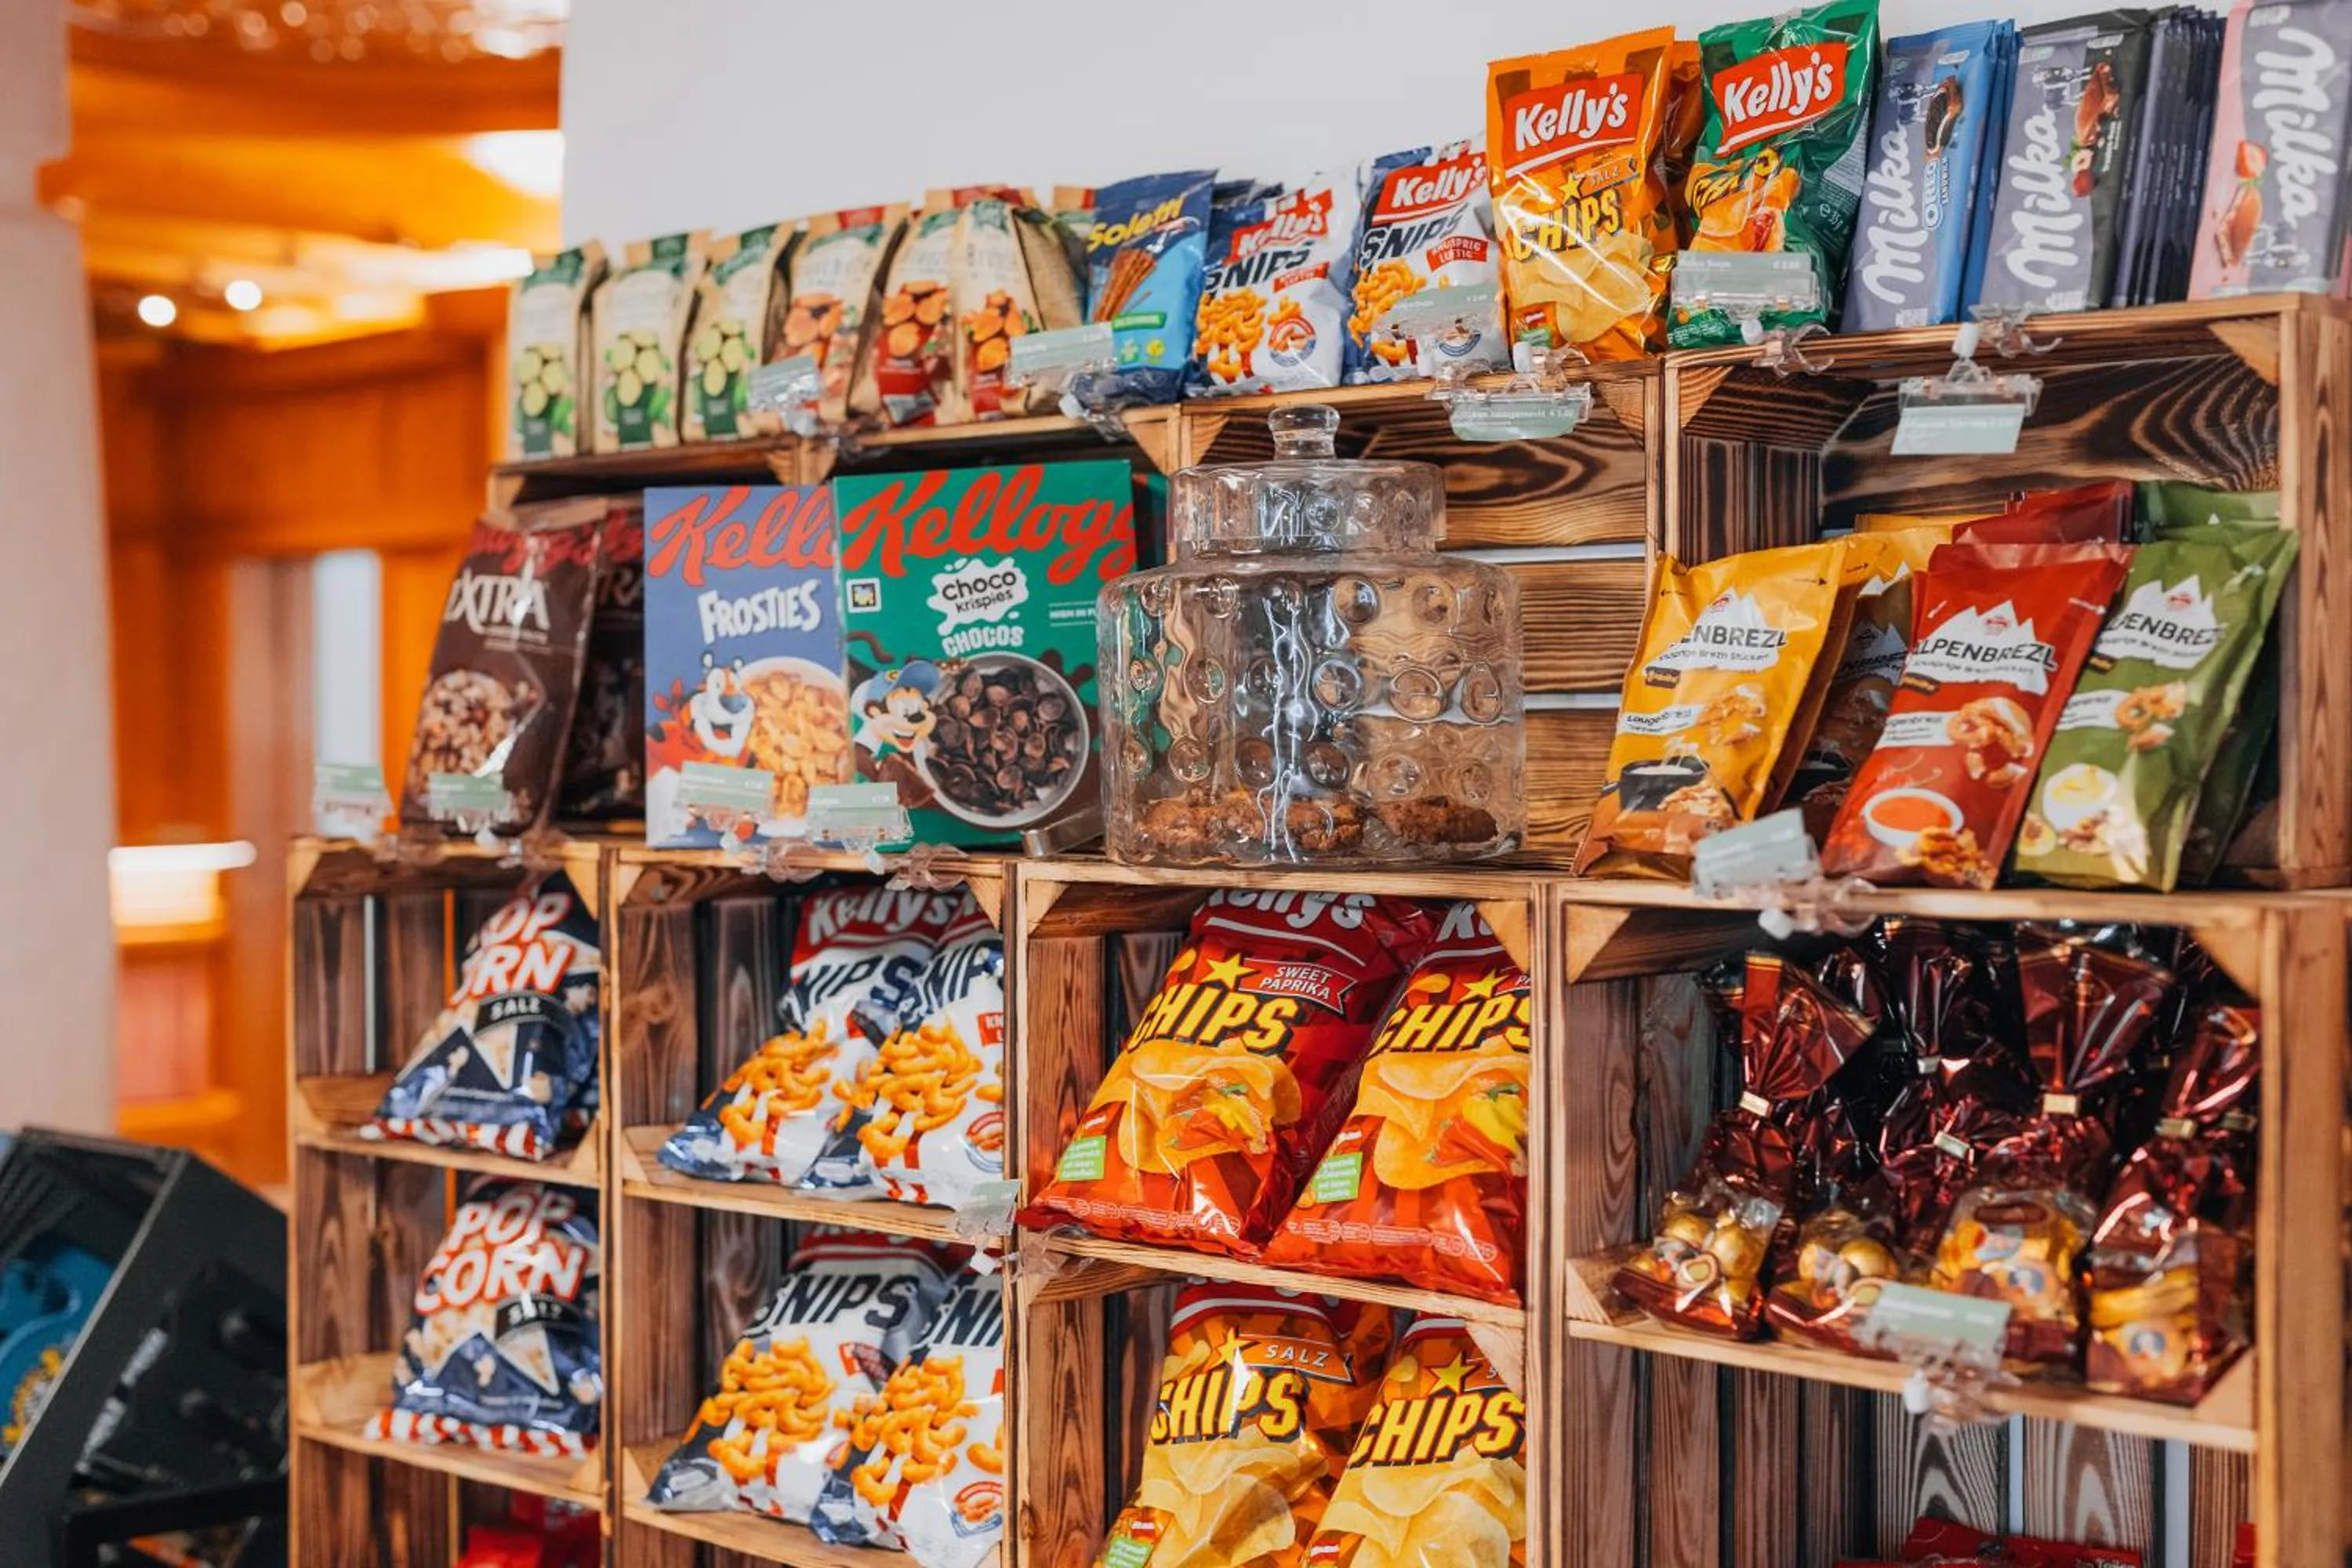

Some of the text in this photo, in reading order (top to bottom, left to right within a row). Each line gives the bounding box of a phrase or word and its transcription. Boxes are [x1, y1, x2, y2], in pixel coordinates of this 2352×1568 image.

[1515, 82, 1629, 152] Kelly's
[1726, 50, 1834, 127] Kelly's
[2252, 27, 2338, 230] Milka
[1509, 188, 1621, 261] CHIPS
[1862, 120, 1929, 304] Milka
[1924, 159, 1941, 228] OREO
[2007, 104, 2083, 288] Milka
[445, 568, 550, 634] XTRA
[697, 578, 823, 644] FROSTIES
[942, 572, 1017, 601] choco
[956, 589, 1014, 614] krispies
[942, 625, 1025, 657] CHOCOS
[1258, 977, 1331, 1000] PAPRIKA
[1274, 966, 1333, 984] SWEET
[1130, 982, 1301, 1053] CHIPS
[448, 1187, 575, 1253] POP
[414, 1239, 587, 1315] CORN
[1265, 1344, 1330, 1368] SALZ
[1151, 1367, 1305, 1443] CHIPS
[1347, 1392, 1526, 1468] CHIPS
